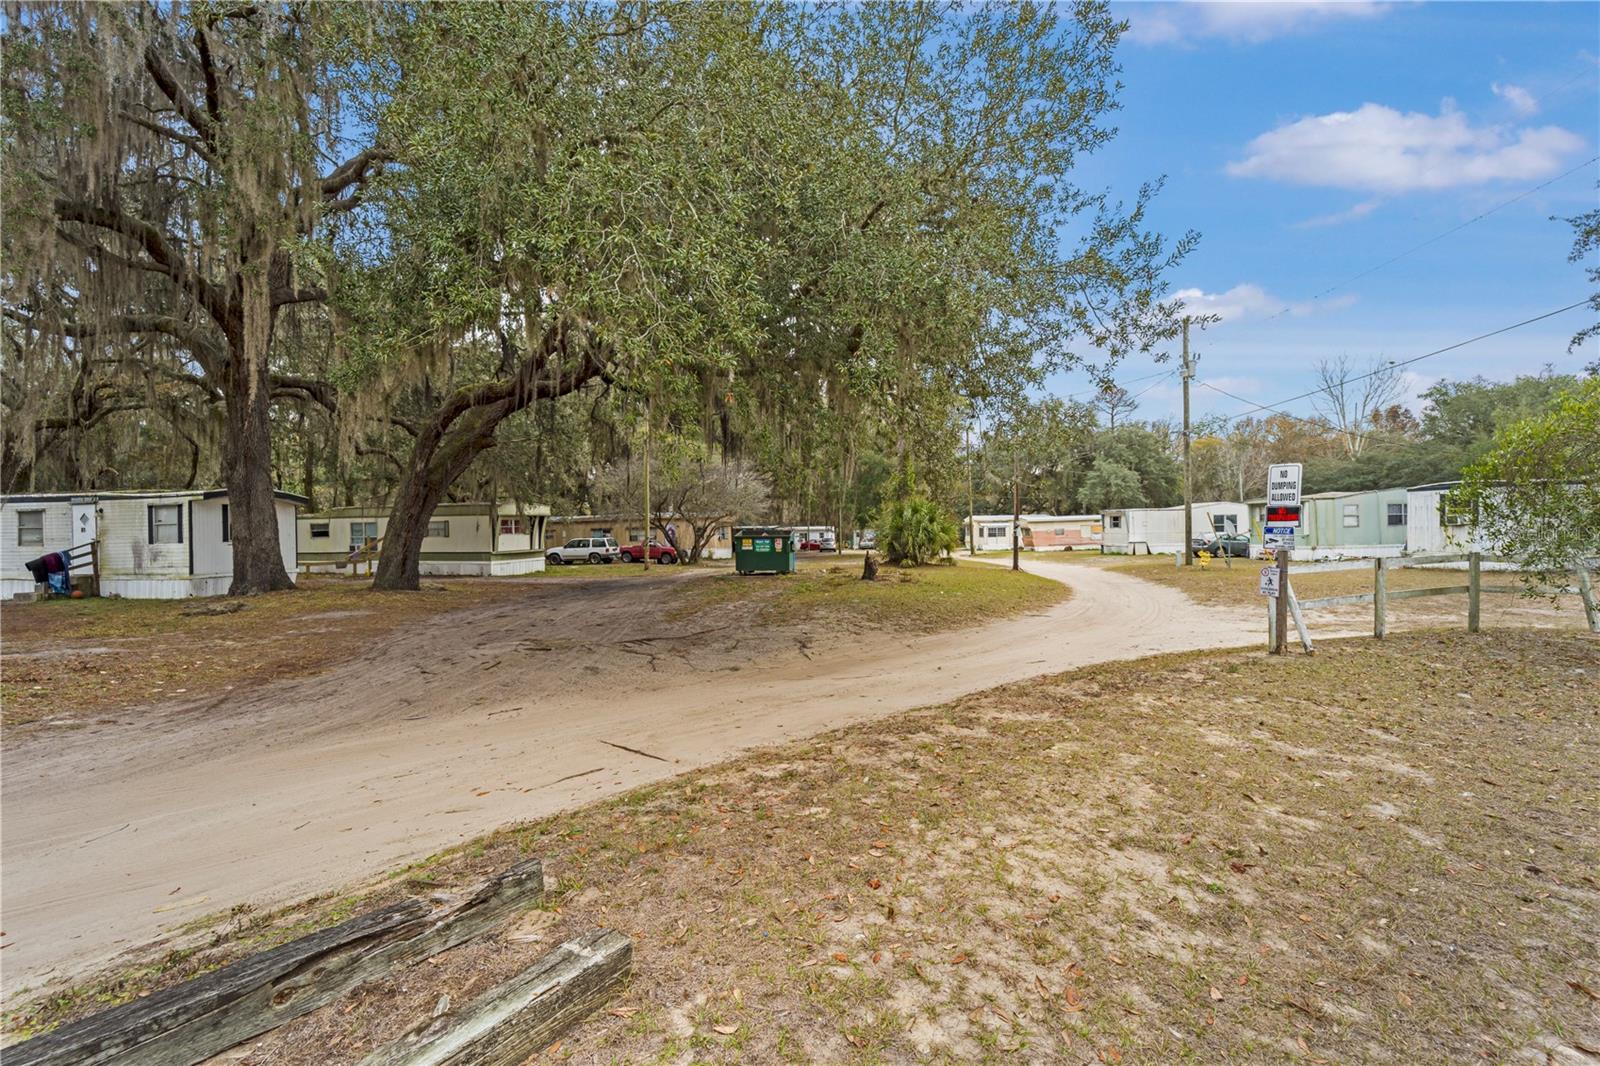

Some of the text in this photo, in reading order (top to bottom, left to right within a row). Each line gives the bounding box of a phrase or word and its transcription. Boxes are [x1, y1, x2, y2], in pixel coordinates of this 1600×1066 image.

[1280, 470, 1288, 478] NO
[1272, 481, 1296, 490] DUMPING
[1272, 492, 1296, 502] ALLOWED
